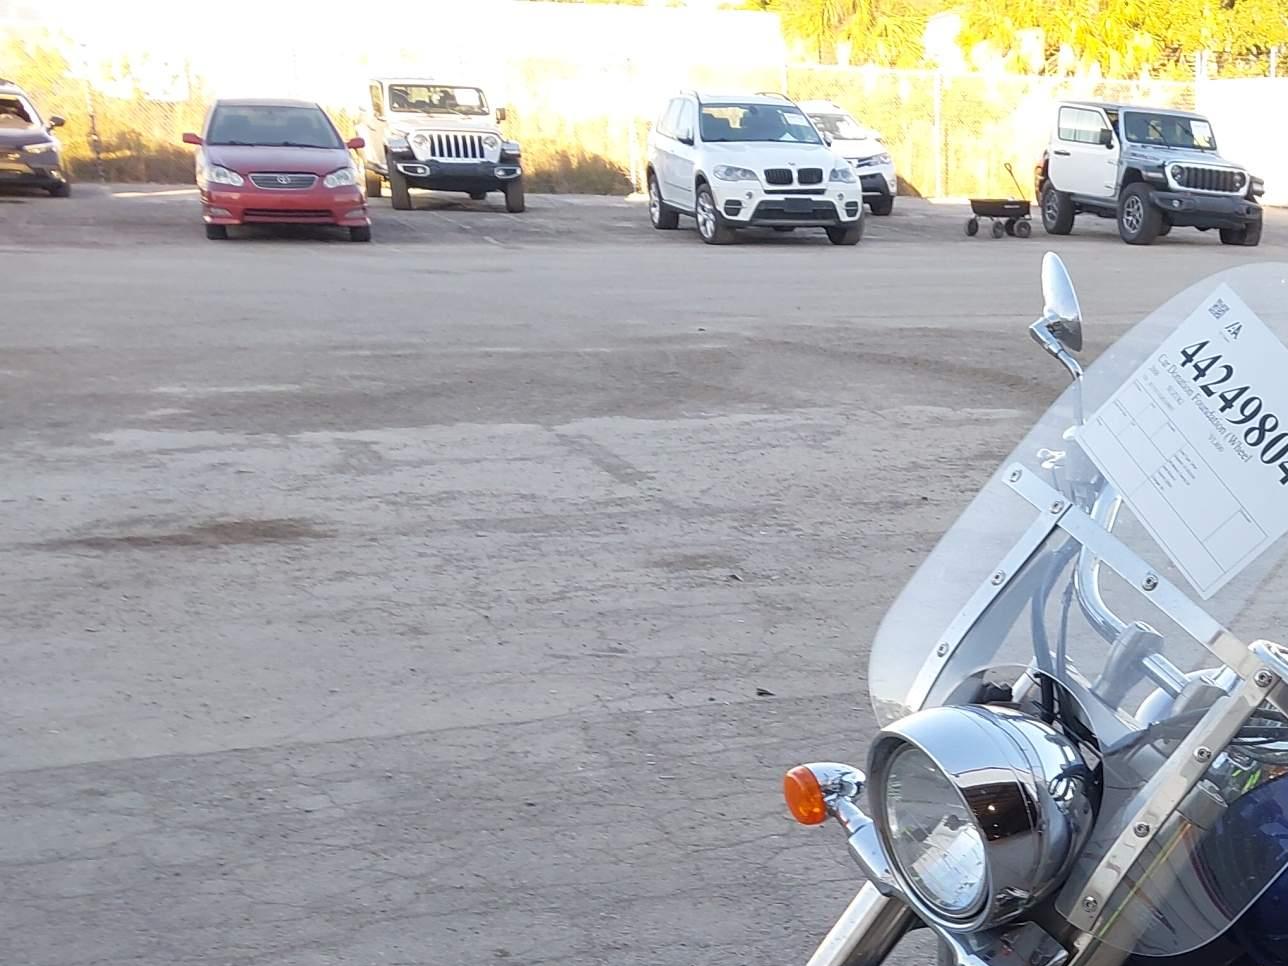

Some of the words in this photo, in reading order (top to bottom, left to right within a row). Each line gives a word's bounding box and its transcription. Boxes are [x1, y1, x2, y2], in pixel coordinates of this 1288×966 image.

[1157, 353, 1171, 369] Car
[1167, 364, 1195, 397] Donation
[1191, 392, 1228, 435] Foundation
